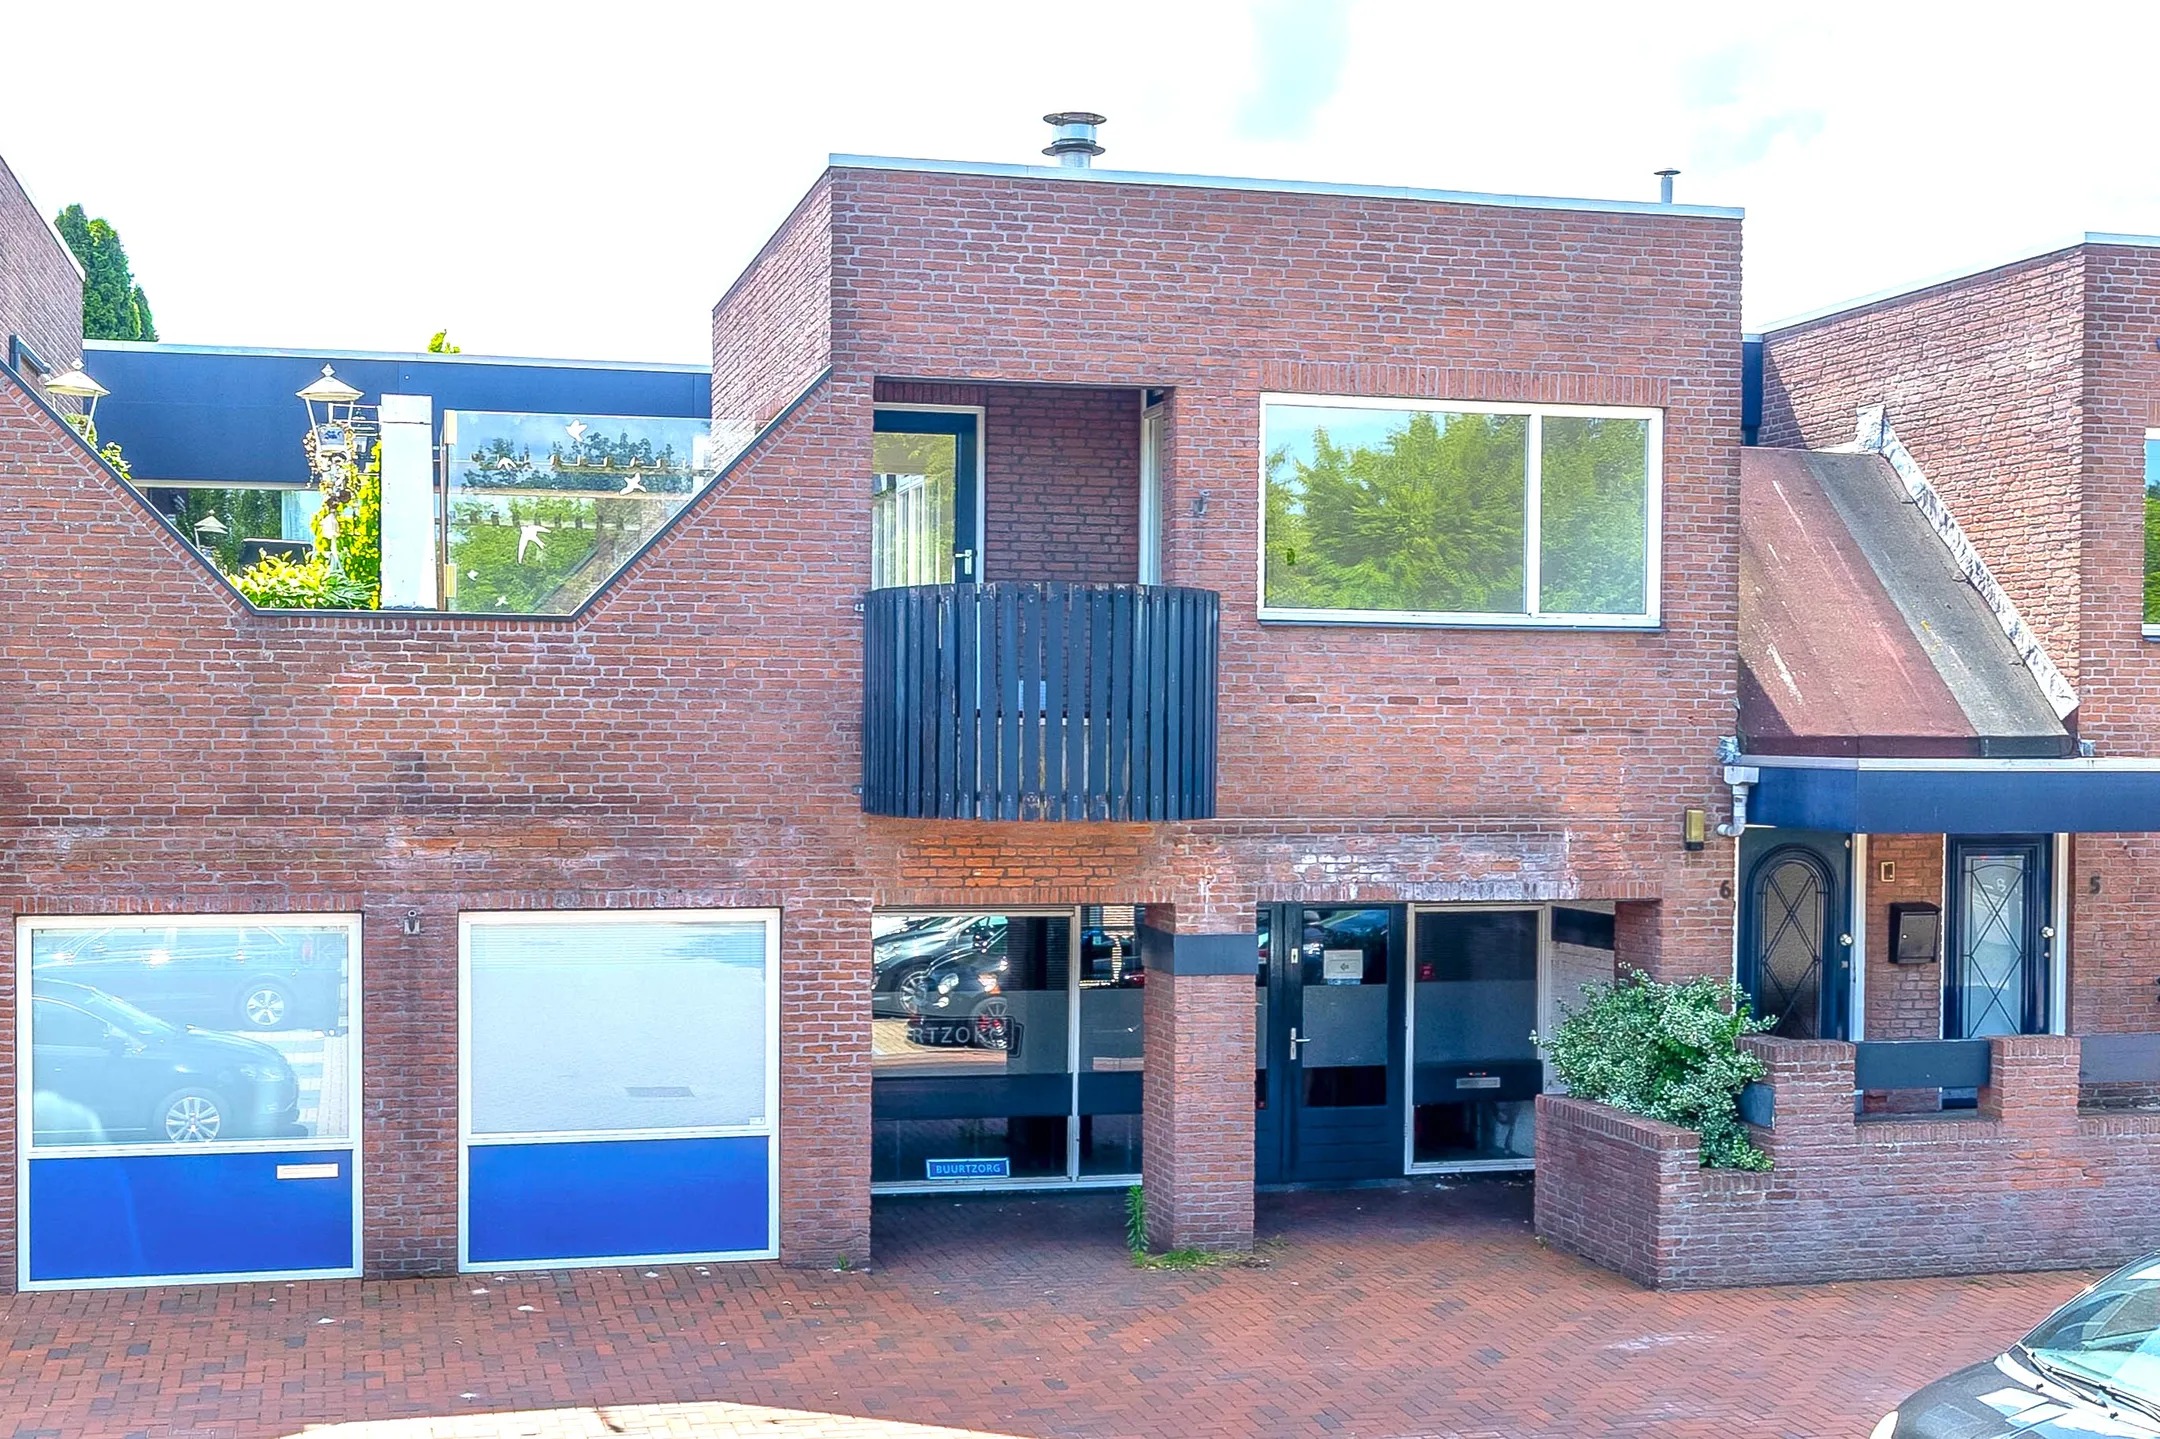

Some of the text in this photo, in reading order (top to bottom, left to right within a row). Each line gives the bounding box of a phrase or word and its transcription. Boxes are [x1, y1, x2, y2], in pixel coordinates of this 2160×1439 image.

[1720, 880, 1731, 899] 6
[2090, 876, 2100, 895] 5
[936, 1164, 1001, 1174] BUURTZORG
